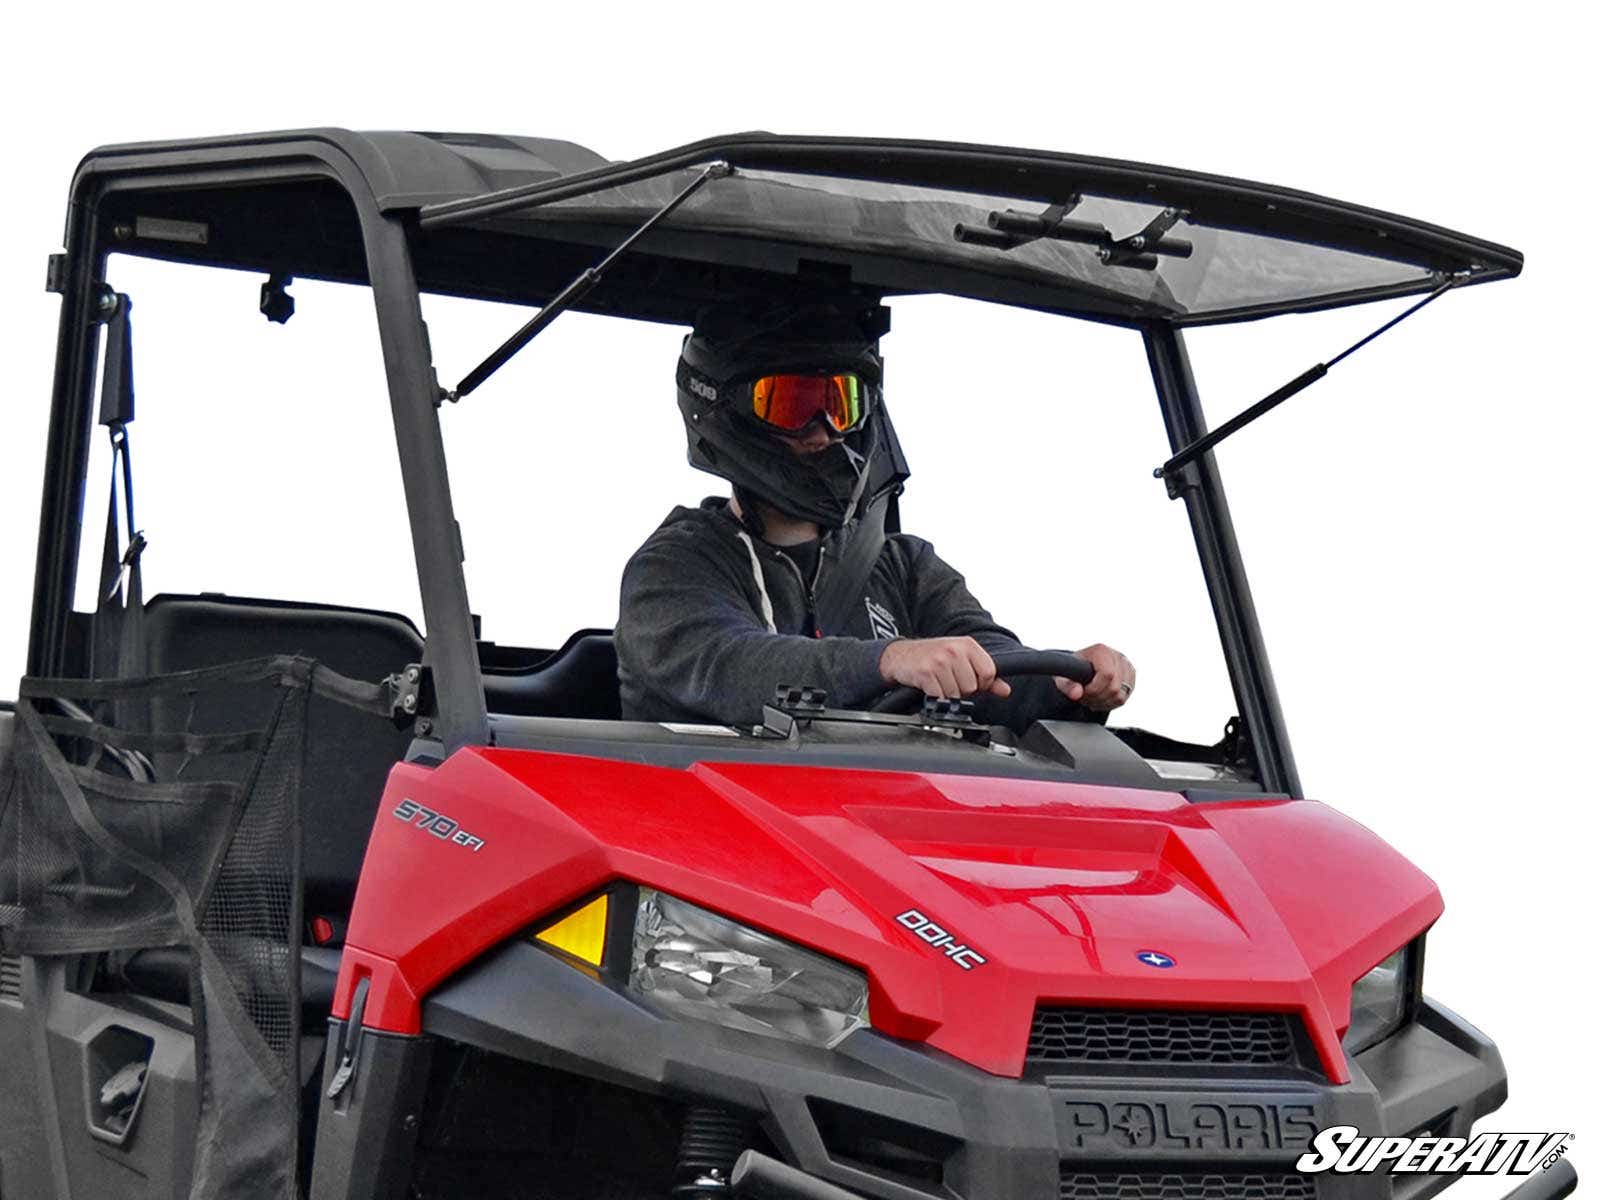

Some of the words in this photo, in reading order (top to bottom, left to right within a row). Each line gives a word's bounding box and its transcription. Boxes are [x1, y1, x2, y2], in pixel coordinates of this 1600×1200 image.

[393, 798, 459, 840] 570
[896, 908, 988, 971] DOHC
[1063, 1100, 1320, 1149] POLARIS
